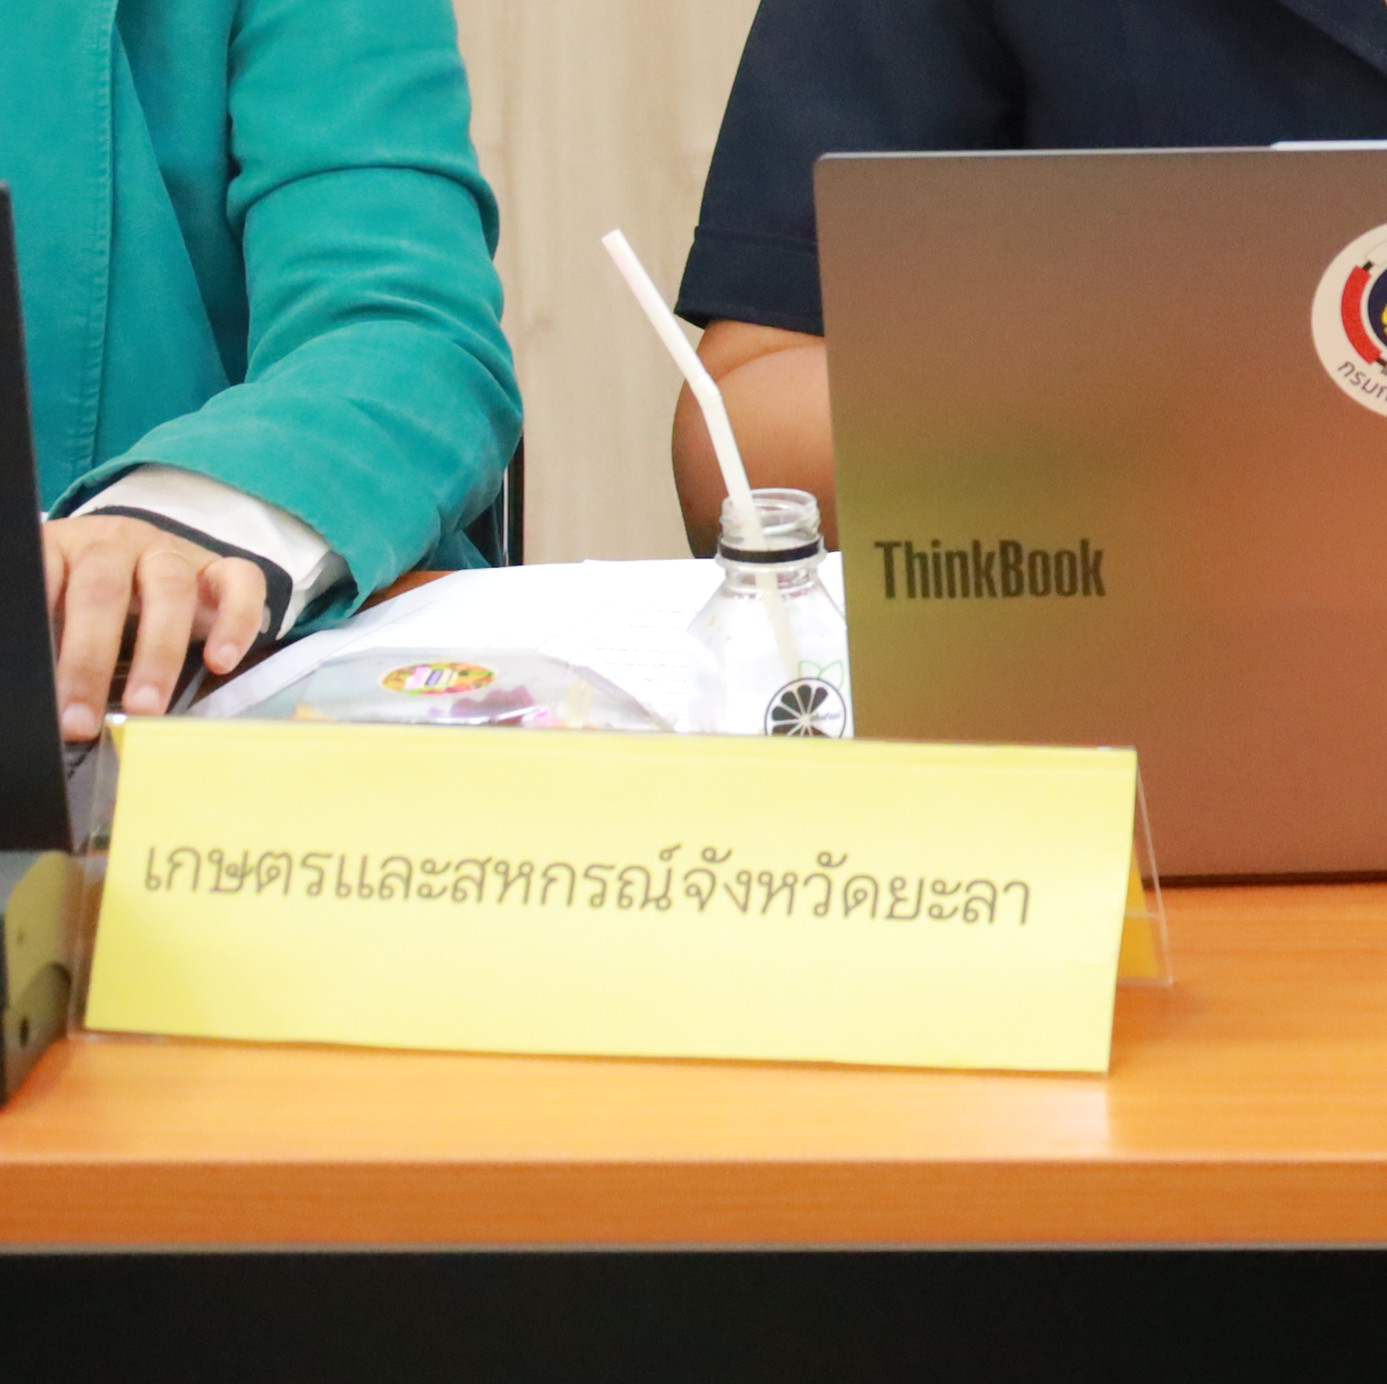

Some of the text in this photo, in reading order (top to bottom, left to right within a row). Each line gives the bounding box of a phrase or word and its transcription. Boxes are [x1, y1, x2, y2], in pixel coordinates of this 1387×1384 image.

[873, 538, 1107, 600] ThinkBook
[142, 842, 1032, 926] เกษตรและสหกรณ์จังหวัดยะลา
